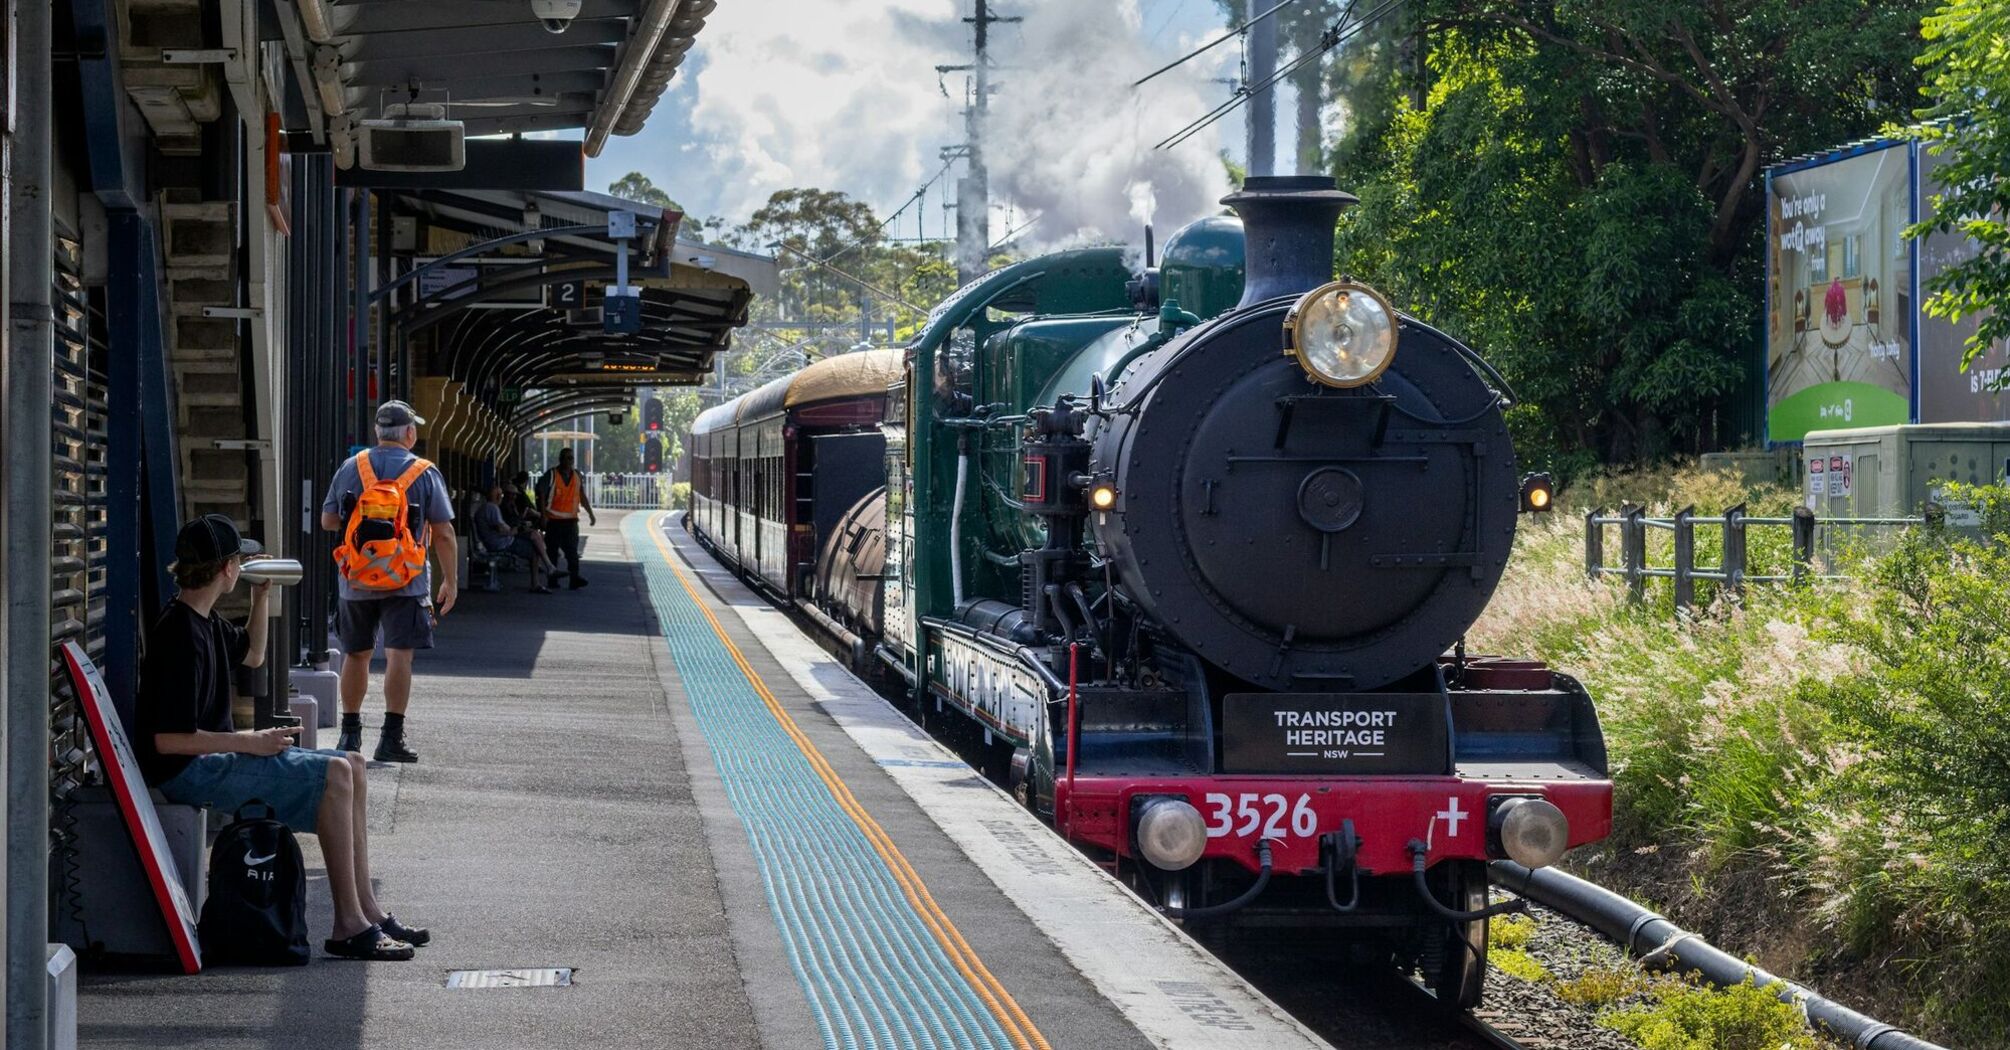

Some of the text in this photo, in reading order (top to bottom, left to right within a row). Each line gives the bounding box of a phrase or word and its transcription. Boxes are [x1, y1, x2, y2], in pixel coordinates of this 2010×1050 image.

[1781, 188, 1825, 219] You're only a
[1805, 225, 1825, 250] away
[561, 283, 575, 301] 2
[1970, 369, 1978, 393] is
[1274, 711, 1397, 727] TRANSPORT
[1286, 730, 1385, 745] HERITAGE
[1323, 750, 1349, 759] NSW
[1205, 792, 1318, 838] 3526
[247, 868, 274, 881] AIR
